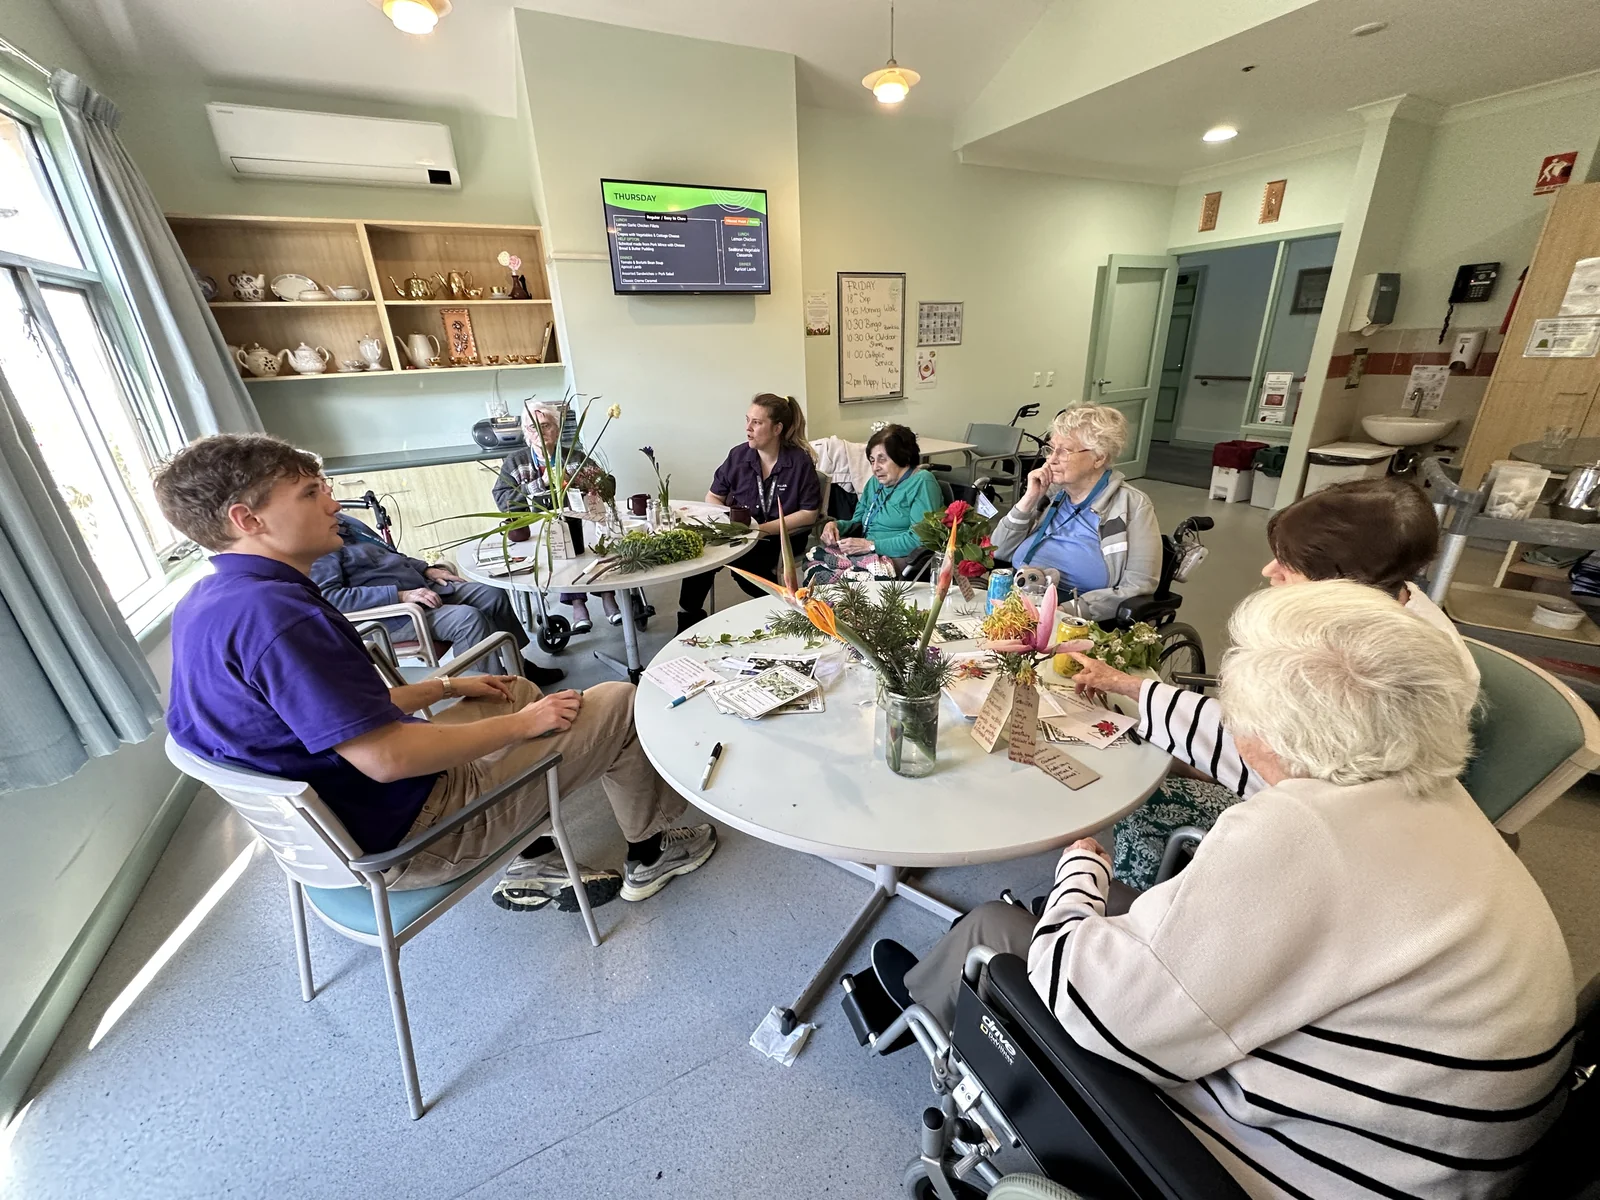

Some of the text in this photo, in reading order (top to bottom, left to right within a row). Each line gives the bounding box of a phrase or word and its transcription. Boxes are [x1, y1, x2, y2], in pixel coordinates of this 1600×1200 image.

[614, 192, 656, 202] THURSDAY
[845, 280, 876, 292] FRIDAY
[864, 318, 882, 332] Bingo
[863, 374, 879, 389] Happy
[882, 378, 897, 389] Hour
[982, 1015, 1016, 1056] drive
